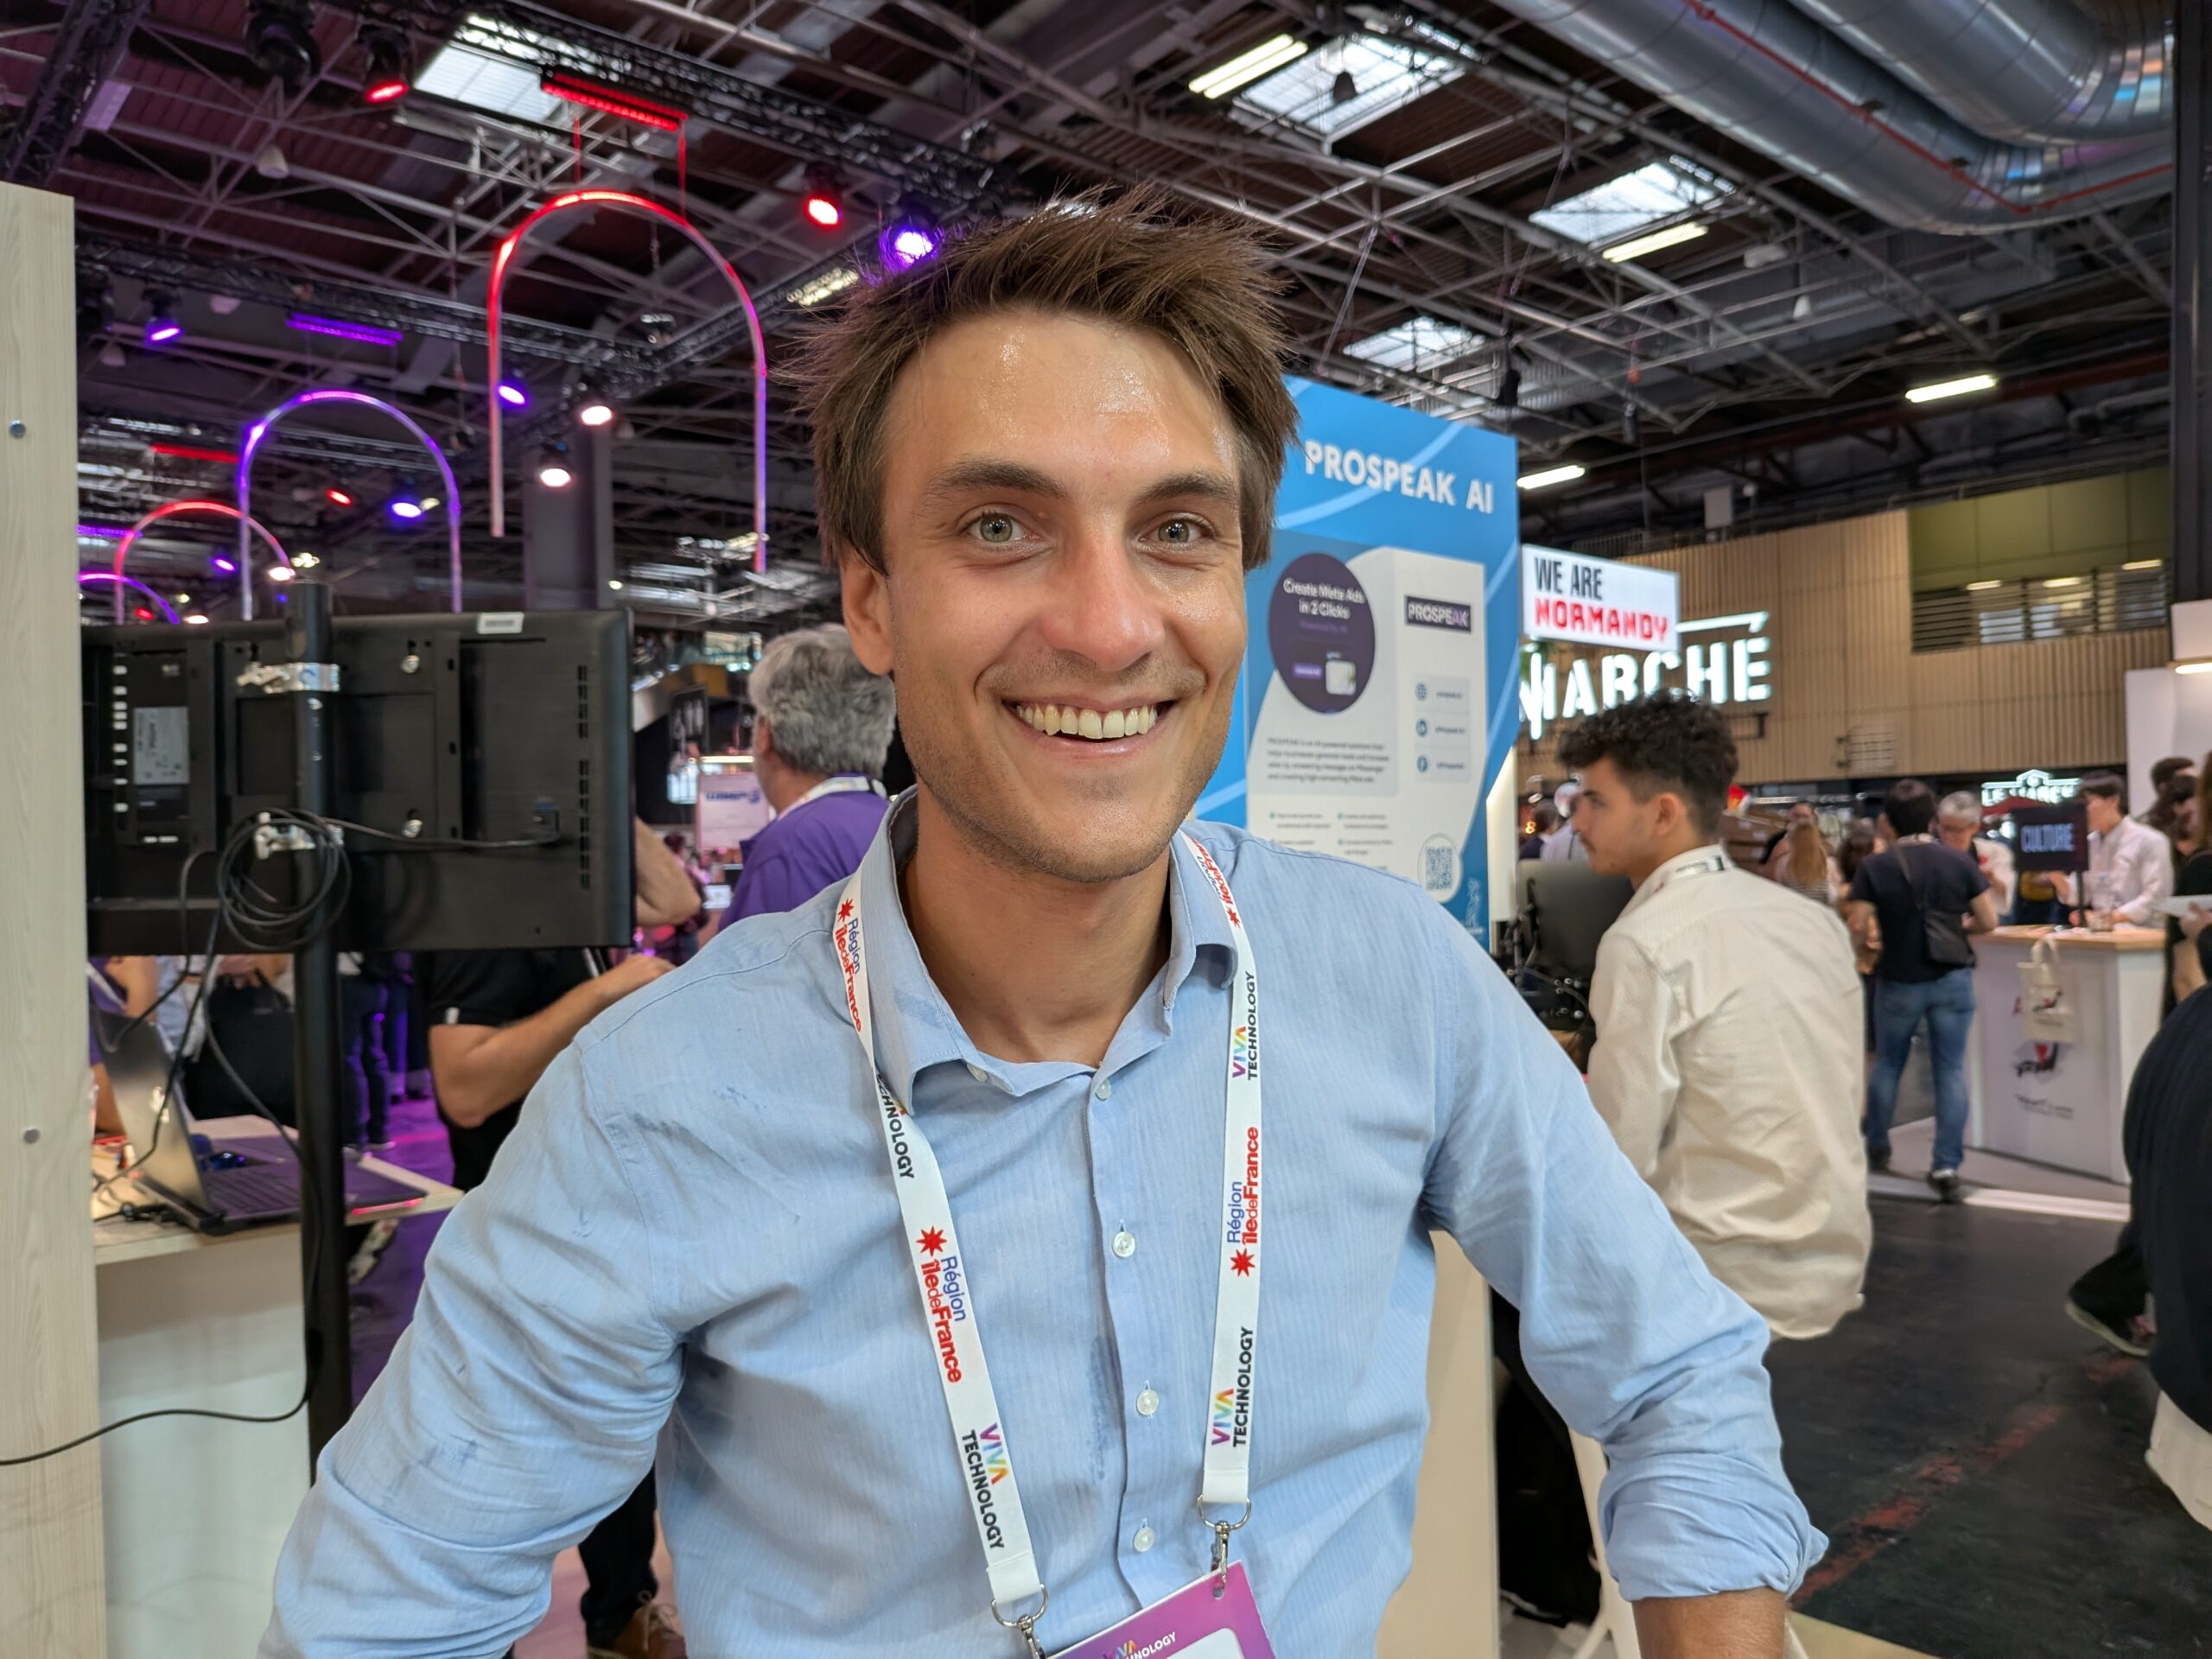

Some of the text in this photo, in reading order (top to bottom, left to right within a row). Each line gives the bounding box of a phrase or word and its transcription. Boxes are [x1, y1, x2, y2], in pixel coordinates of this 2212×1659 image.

[1305, 439, 1494, 514] PROSPEAK AI
[1283, 577, 1319, 597] Create
[1534, 556, 1604, 600] WE ARE
[1311, 600, 1319, 615] 2
[1319, 601, 1351, 620] Clicks
[1408, 601, 1469, 628] PROSPEAK
[1534, 598, 1669, 642] NORMANDY
[2020, 823, 2075, 853] CULTURE
[848, 918, 861, 974] Région
[1231, 1026, 1247, 1078] VIVA
[1245, 971, 1258, 1081] TECHNOLOGY
[1226, 1180, 1245, 1244] Région
[940, 1255, 966, 1322] Région
[1233, 1326, 1255, 1448] TECHNOLOGY
[1211, 1388, 1235, 1446] VIVA
[979, 1422, 1009, 1485] VIVA
[962, 1429, 1005, 1550] TECHNOLOGY
